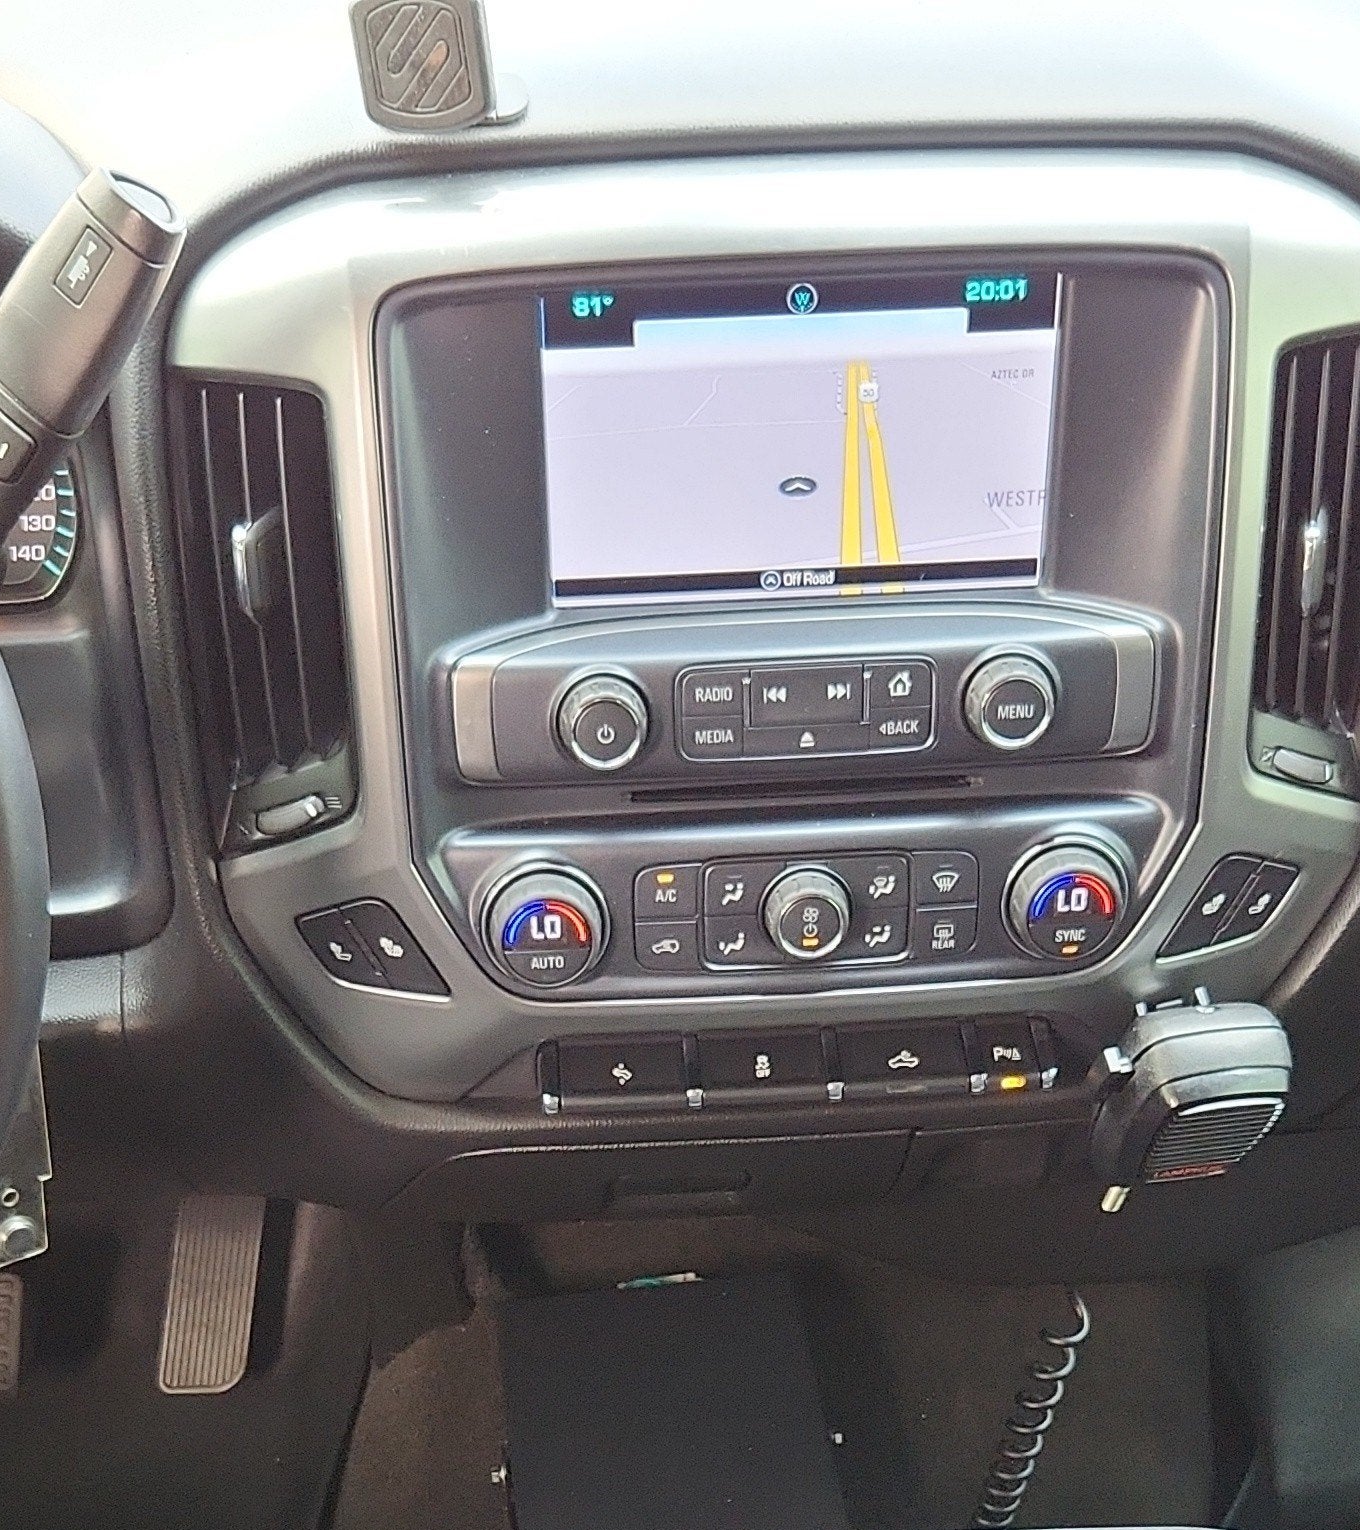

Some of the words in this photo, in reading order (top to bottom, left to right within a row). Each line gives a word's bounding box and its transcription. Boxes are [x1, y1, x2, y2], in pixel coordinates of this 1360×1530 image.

[965, 278, 1028, 301] 20:01
[19, 514, 56, 532] 130
[9, 544, 45, 562] 140
[783, 571, 802, 587] Off
[804, 569, 836, 586] Road
[695, 686, 733, 702] RADIO
[997, 702, 1035, 721] MENU
[886, 719, 919, 736] BACK
[695, 729, 734, 745] MEDIA
[654, 889, 678, 903] A/C
[1056, 887, 1089, 913] LO
[529, 914, 562, 940] LO
[931, 939, 955, 950] REAR
[1054, 929, 1086, 943] SYNC
[531, 955, 565, 970] AUTO
